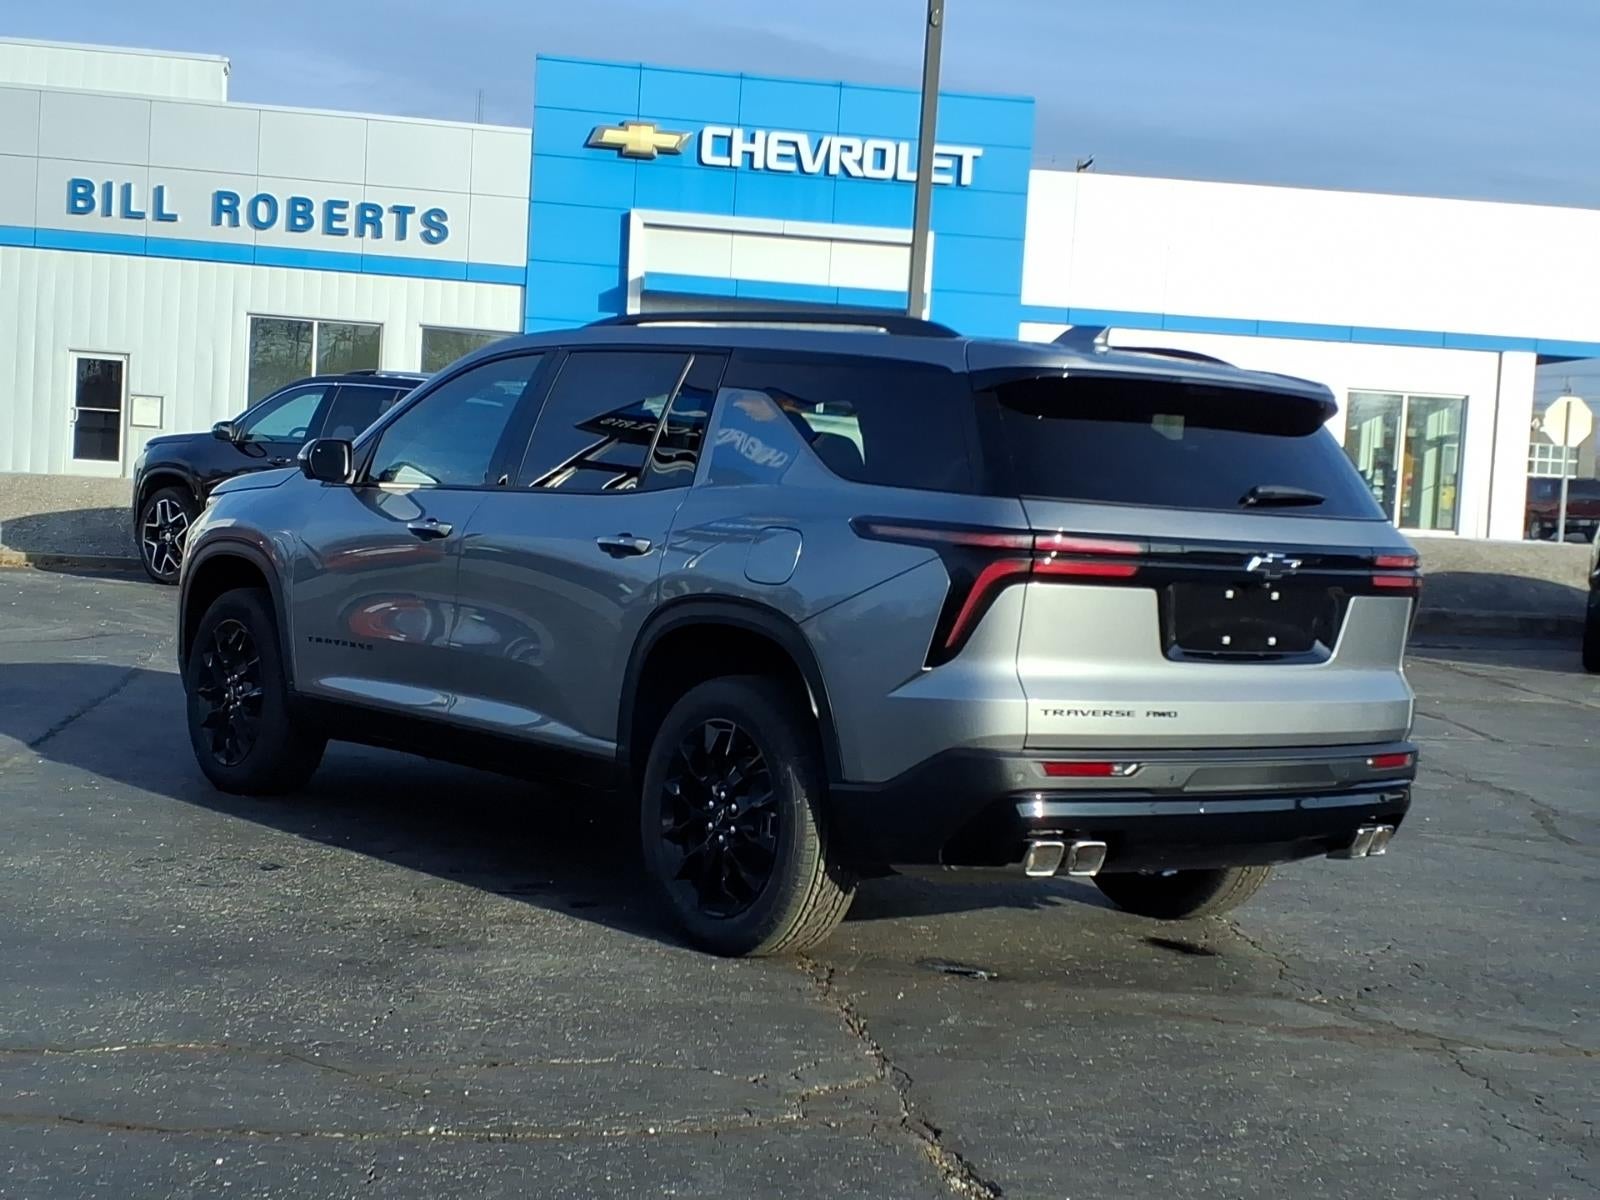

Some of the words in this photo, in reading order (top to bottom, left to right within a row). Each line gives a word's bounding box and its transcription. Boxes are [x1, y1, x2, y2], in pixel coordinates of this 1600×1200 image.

[700, 125, 983, 187] CHEVROLET
[66, 177, 178, 223] BILL
[211, 189, 449, 245] ROBERTS
[1040, 708, 1136, 718] TRAVERSE
[1144, 710, 1179, 719] AWD
